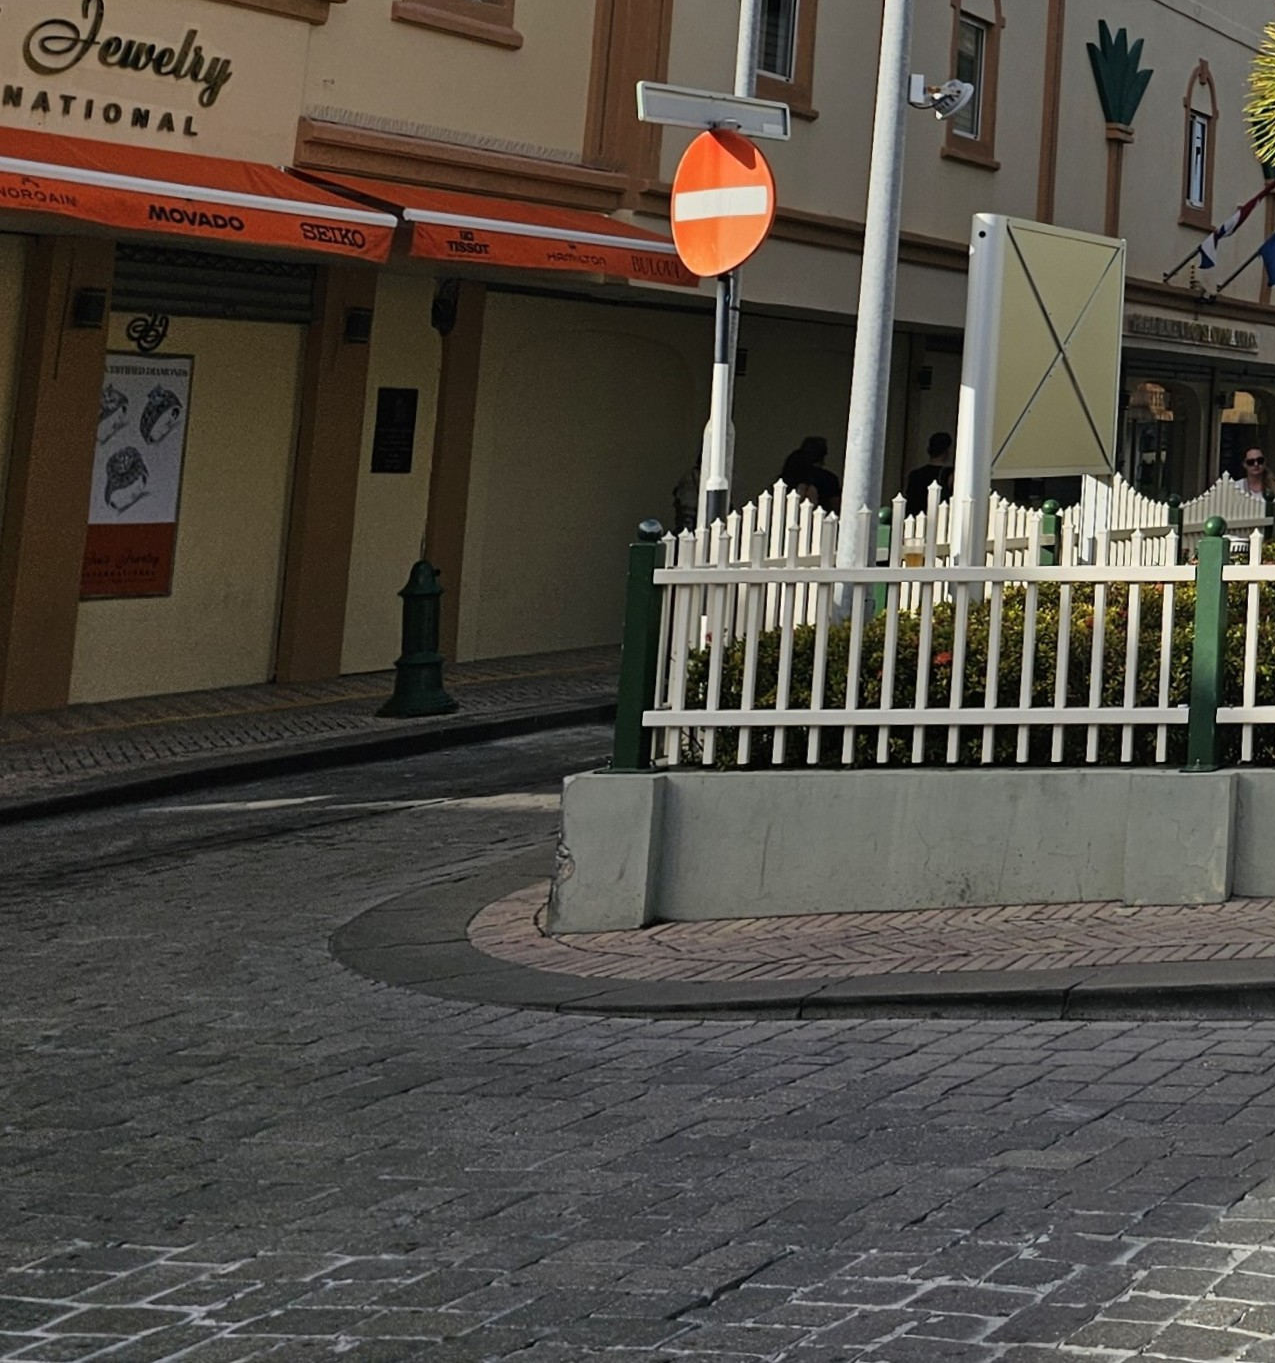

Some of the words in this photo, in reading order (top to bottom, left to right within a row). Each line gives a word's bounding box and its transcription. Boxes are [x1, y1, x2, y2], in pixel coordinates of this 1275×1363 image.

[2, 84, 199, 137] NATIONAL
[149, 204, 245, 232] MOVADO
[299, 221, 367, 250] SEIKO
[447, 240, 490, 255] TISSOT
